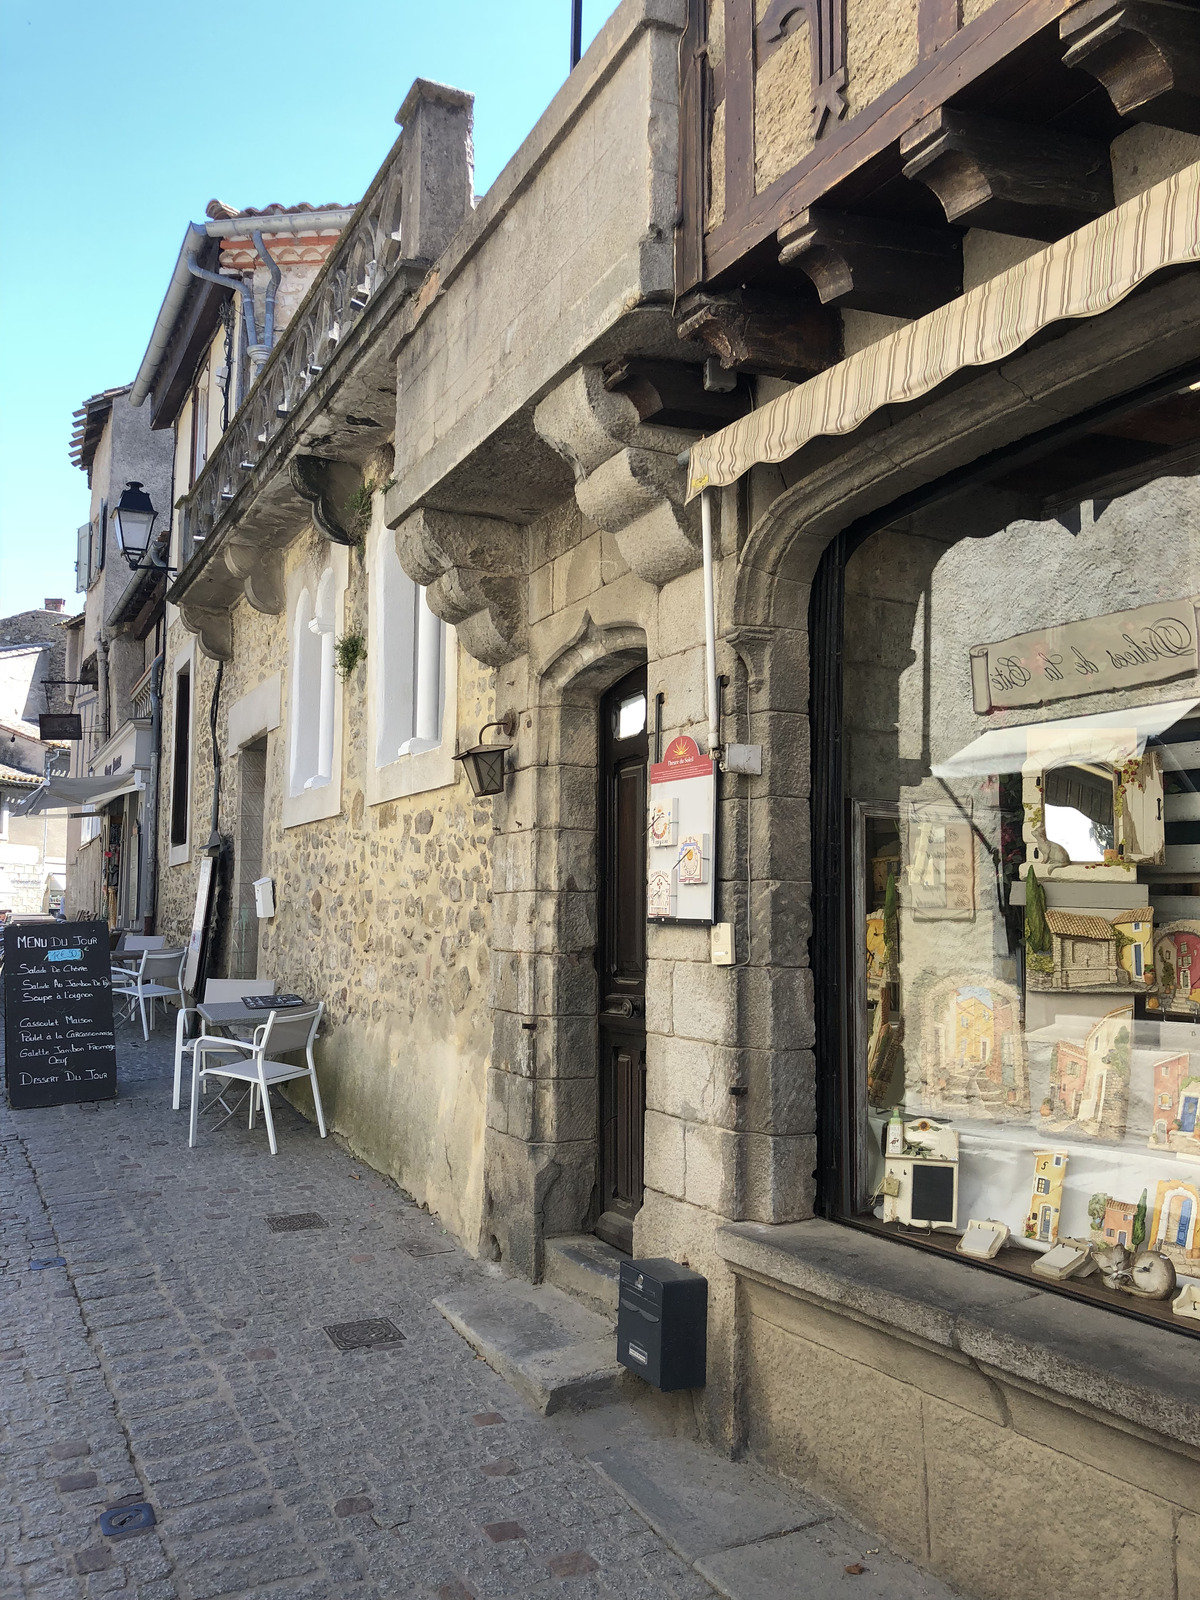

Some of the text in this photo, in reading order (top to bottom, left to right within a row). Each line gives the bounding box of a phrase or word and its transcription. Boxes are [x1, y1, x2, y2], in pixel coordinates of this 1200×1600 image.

[17, 936, 48, 949] MENU
[51, 936, 68, 947] DU
[17, 963, 47, 976] Salade
[21, 979, 50, 991] Salade
[22, 992, 53, 1004] Soupe
[20, 1015, 93, 1028] Cassoulet Maison
[19, 1030, 43, 1042] Poulet
[55, 1031, 63, 1039] la
[20, 1048, 50, 1058] Galette
[53, 1043, 85, 1055] Jambon
